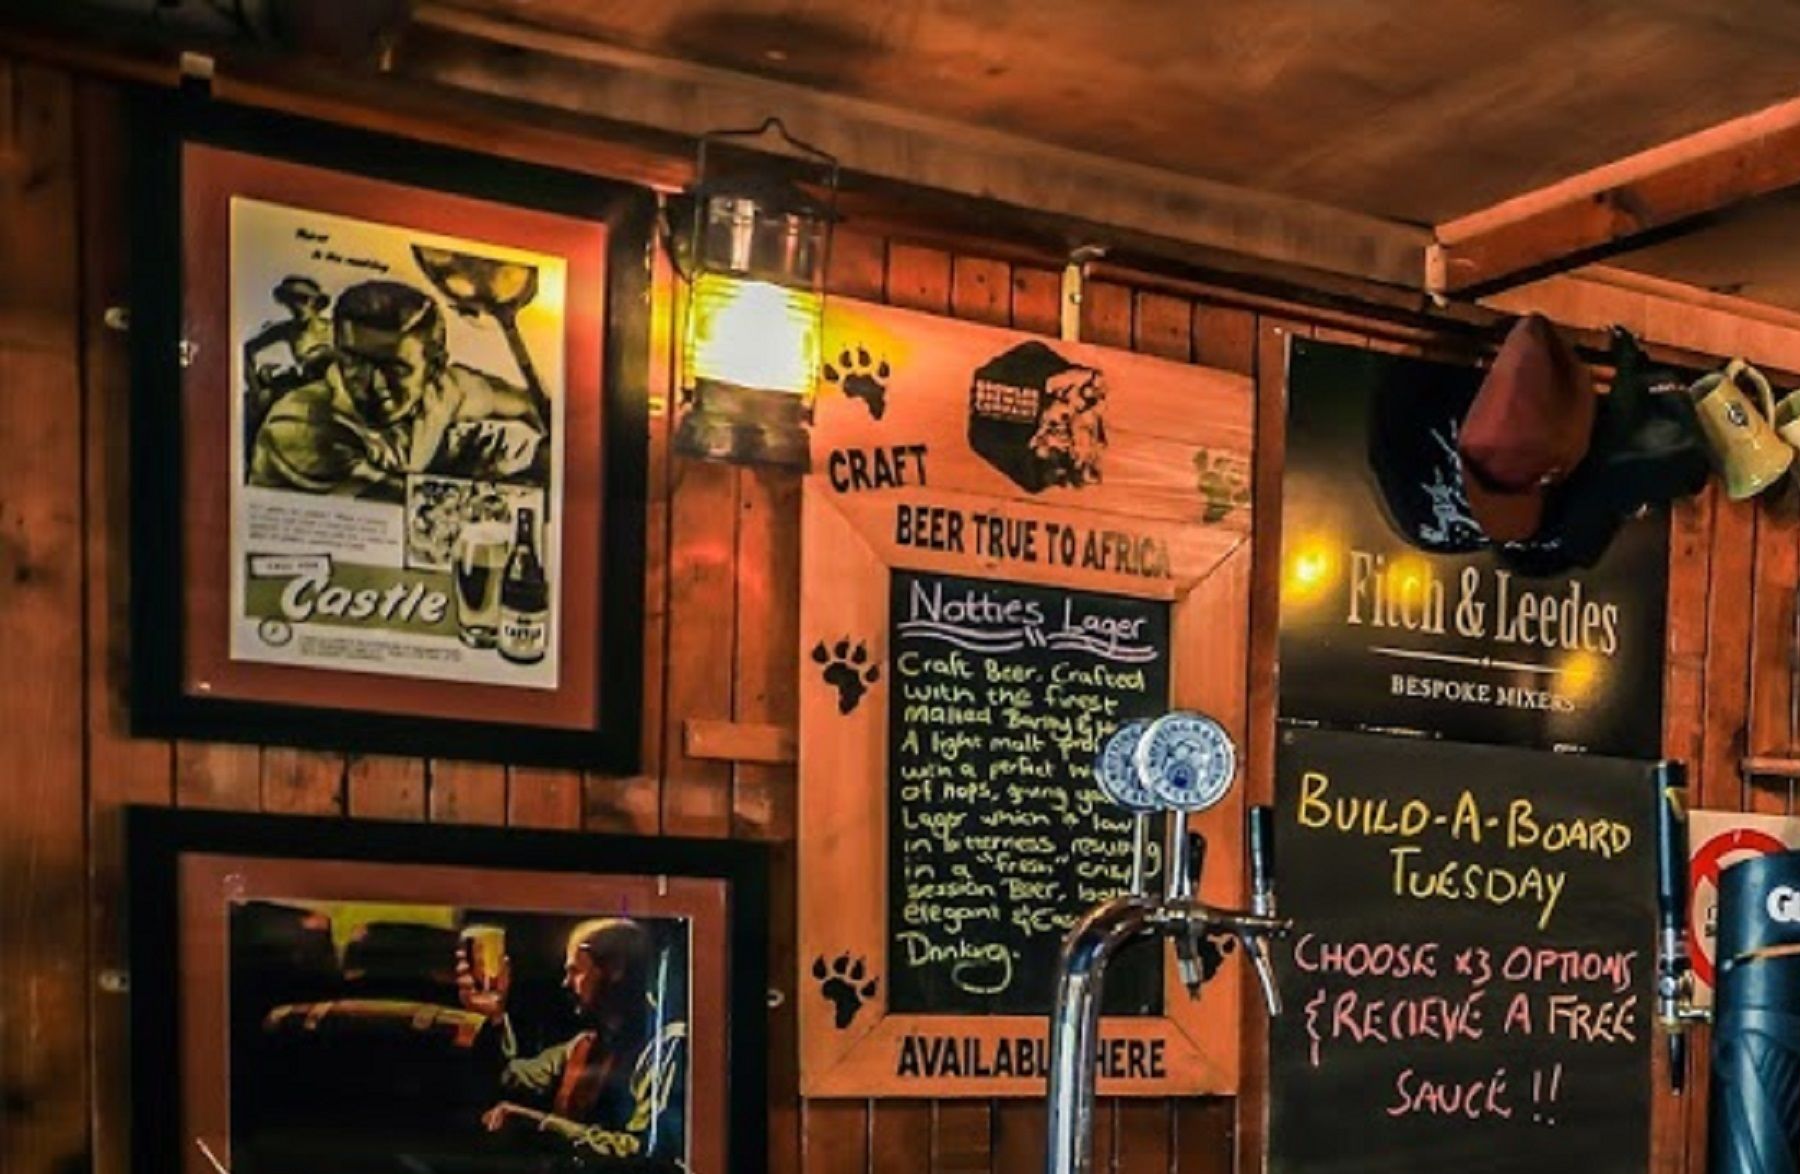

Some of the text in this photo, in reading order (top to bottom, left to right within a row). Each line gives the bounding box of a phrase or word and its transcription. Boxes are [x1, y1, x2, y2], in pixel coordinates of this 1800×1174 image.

[828, 444, 928, 493] CRAFT
[896, 505, 1171, 579] BEER TRUE TO AFRICA
[280, 572, 449, 624] Castle
[909, 579, 1148, 647] Notties Lager
[1346, 550, 1619, 656] Fitch & Leedes
[898, 652, 974, 678] Craft
[987, 686, 1033, 708] the
[1390, 673, 1576, 713] BESPOKE MIXERS
[1297, 772, 1632, 859] BUILD-A-BOARD
[1390, 847, 1566, 930] TUESDAY
[1294, 933, 1439, 977] CHOOSE
[1502, 944, 1638, 994] OPTIONS
[1504, 992, 1532, 1035] A
[1548, 994, 1638, 1044] FREE
[897, 1034, 1167, 1079] AVAILABL HERE
[1386, 1067, 1513, 1119] SAUCE
